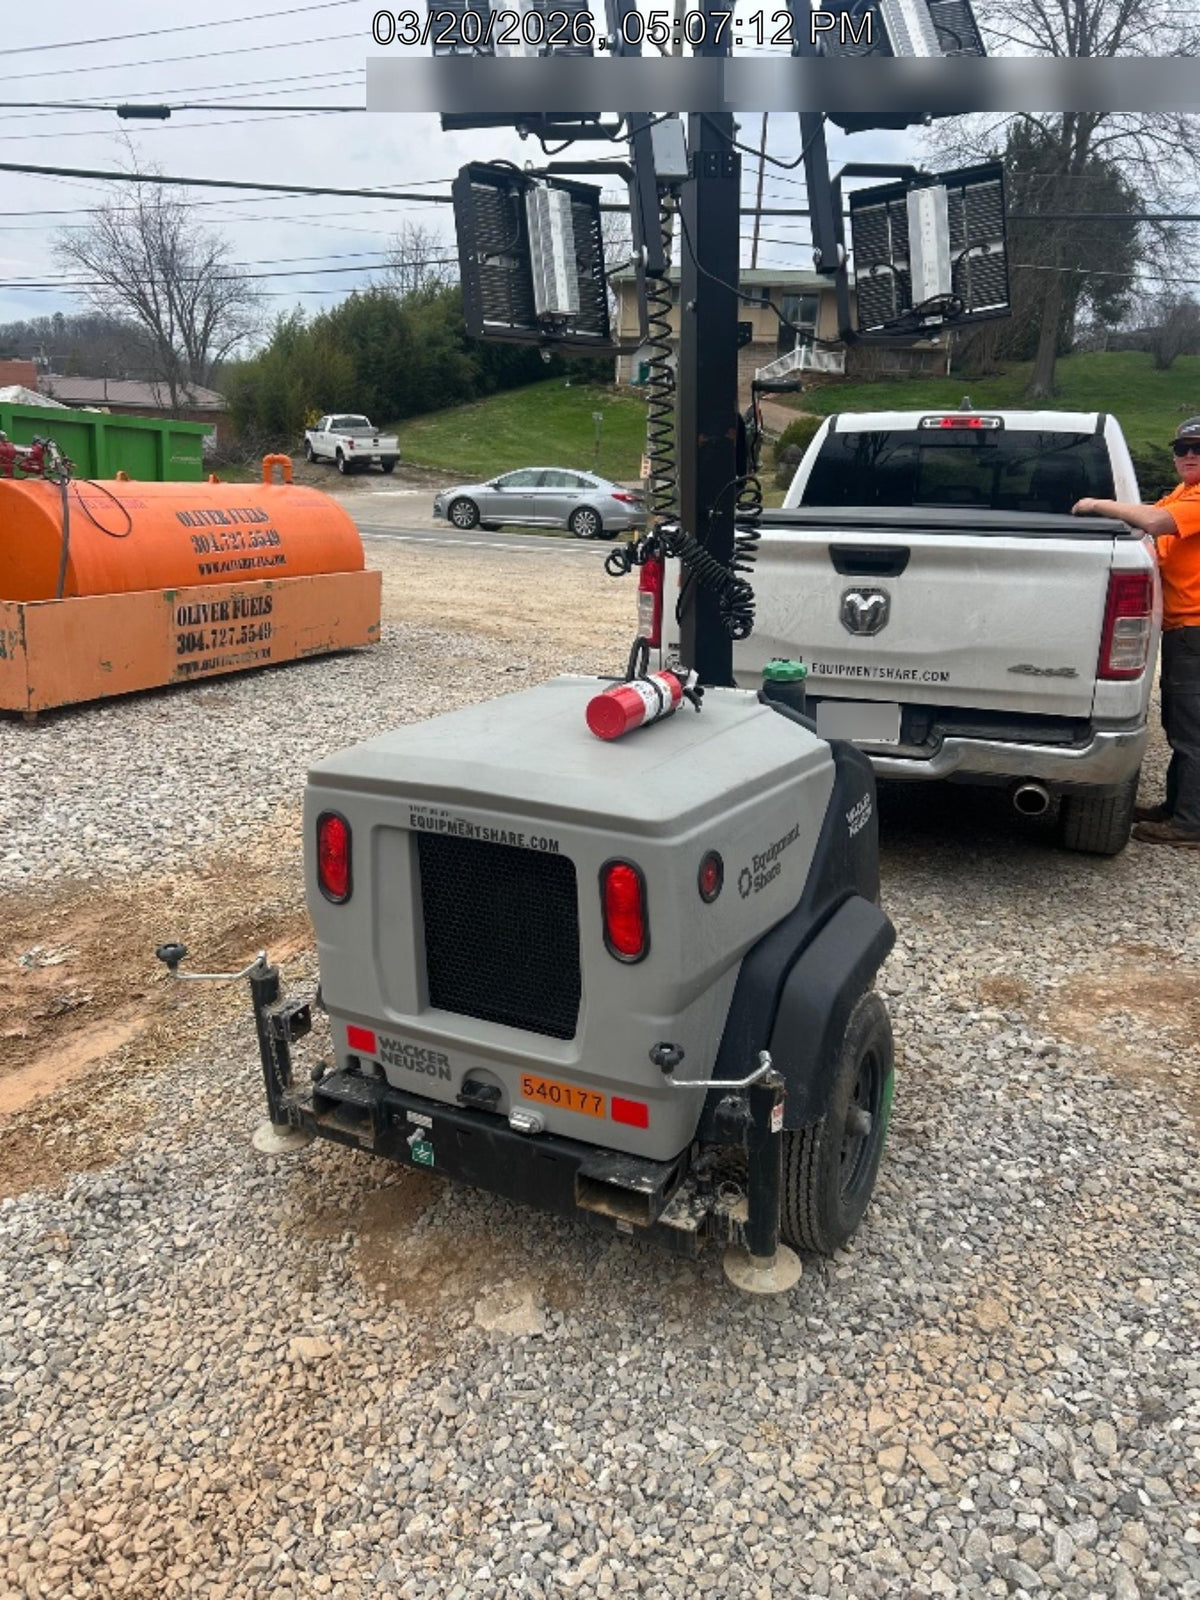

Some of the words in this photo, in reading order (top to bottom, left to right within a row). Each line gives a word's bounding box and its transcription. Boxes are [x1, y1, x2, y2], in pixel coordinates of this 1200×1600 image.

[175, 509, 231, 527] OLIVER
[226, 507, 269, 525] FUELS
[190, 528, 281, 554] 304.727.5549
[177, 600, 230, 627] OLIVER
[232, 595, 273, 620] FUELS
[177, 622, 272, 654] 304.727.5549
[811, 662, 951, 682] EQUIPMENTSHARE.COM
[409, 814, 560, 852] EQUIPMENTSHARE.COM
[751, 824, 801, 872] Equipment
[753, 862, 782, 893] Share
[378, 1036, 449, 1065] WACKER
[380, 1050, 452, 1081] NEUSON
[523, 1078, 603, 1113] 540177
